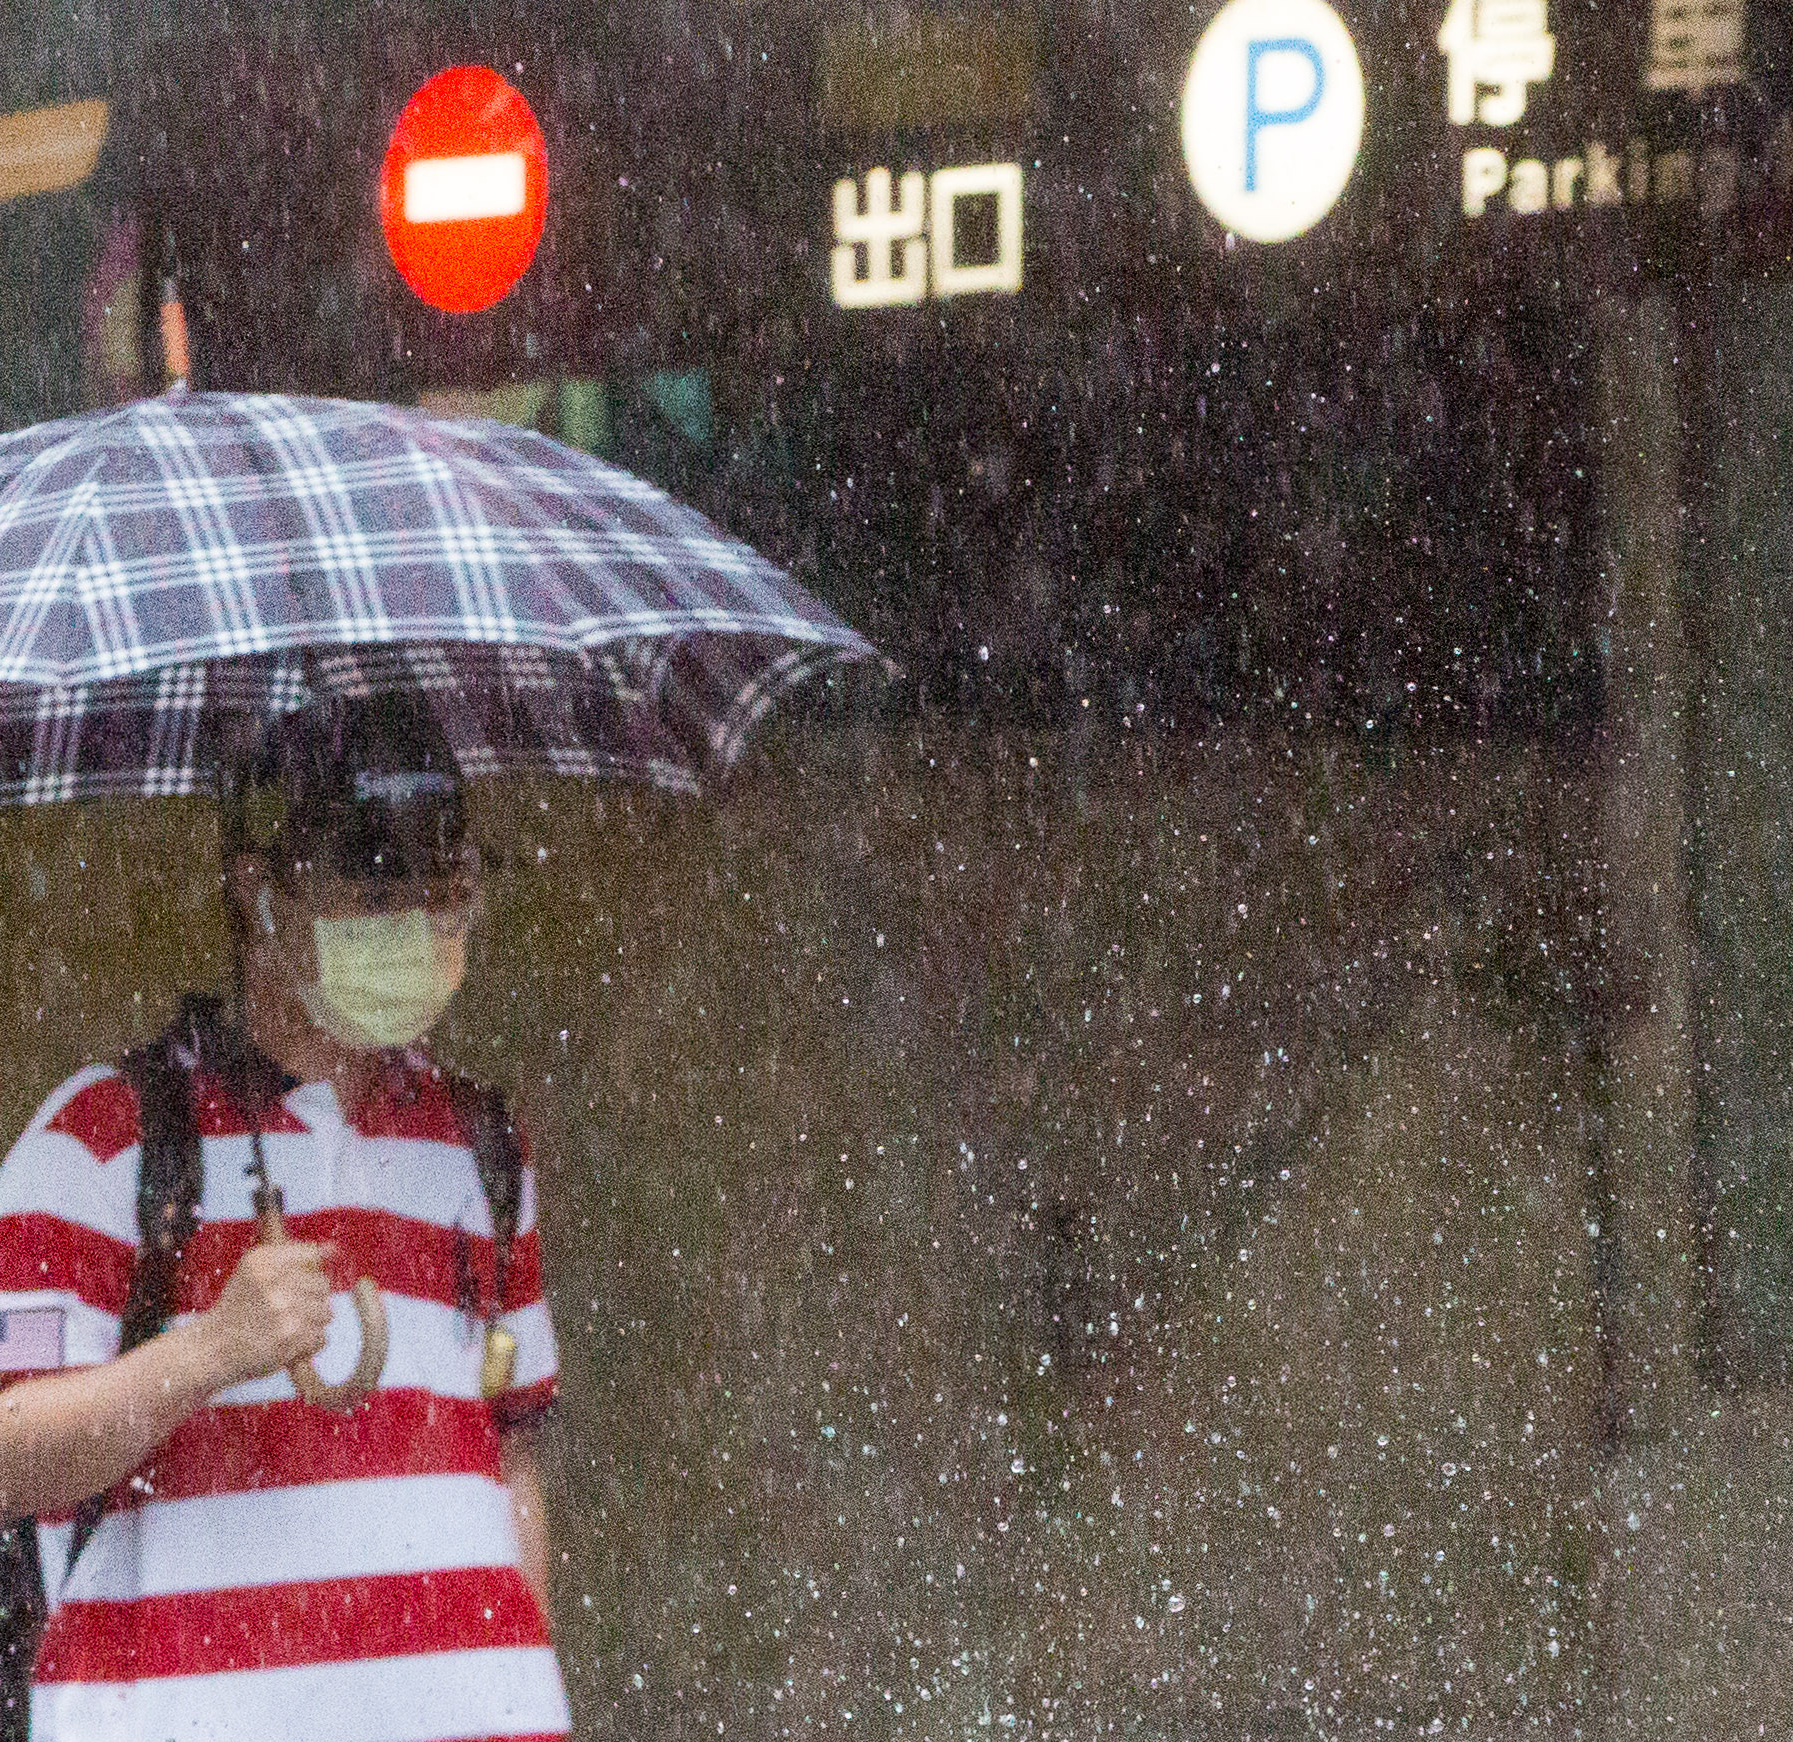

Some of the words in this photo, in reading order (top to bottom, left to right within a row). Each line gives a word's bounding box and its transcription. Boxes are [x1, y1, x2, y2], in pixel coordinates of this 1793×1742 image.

[1244, 38, 1327, 193] P
[1461, 142, 1737, 220] Parking
[830, 162, 1025, 309] 出口
